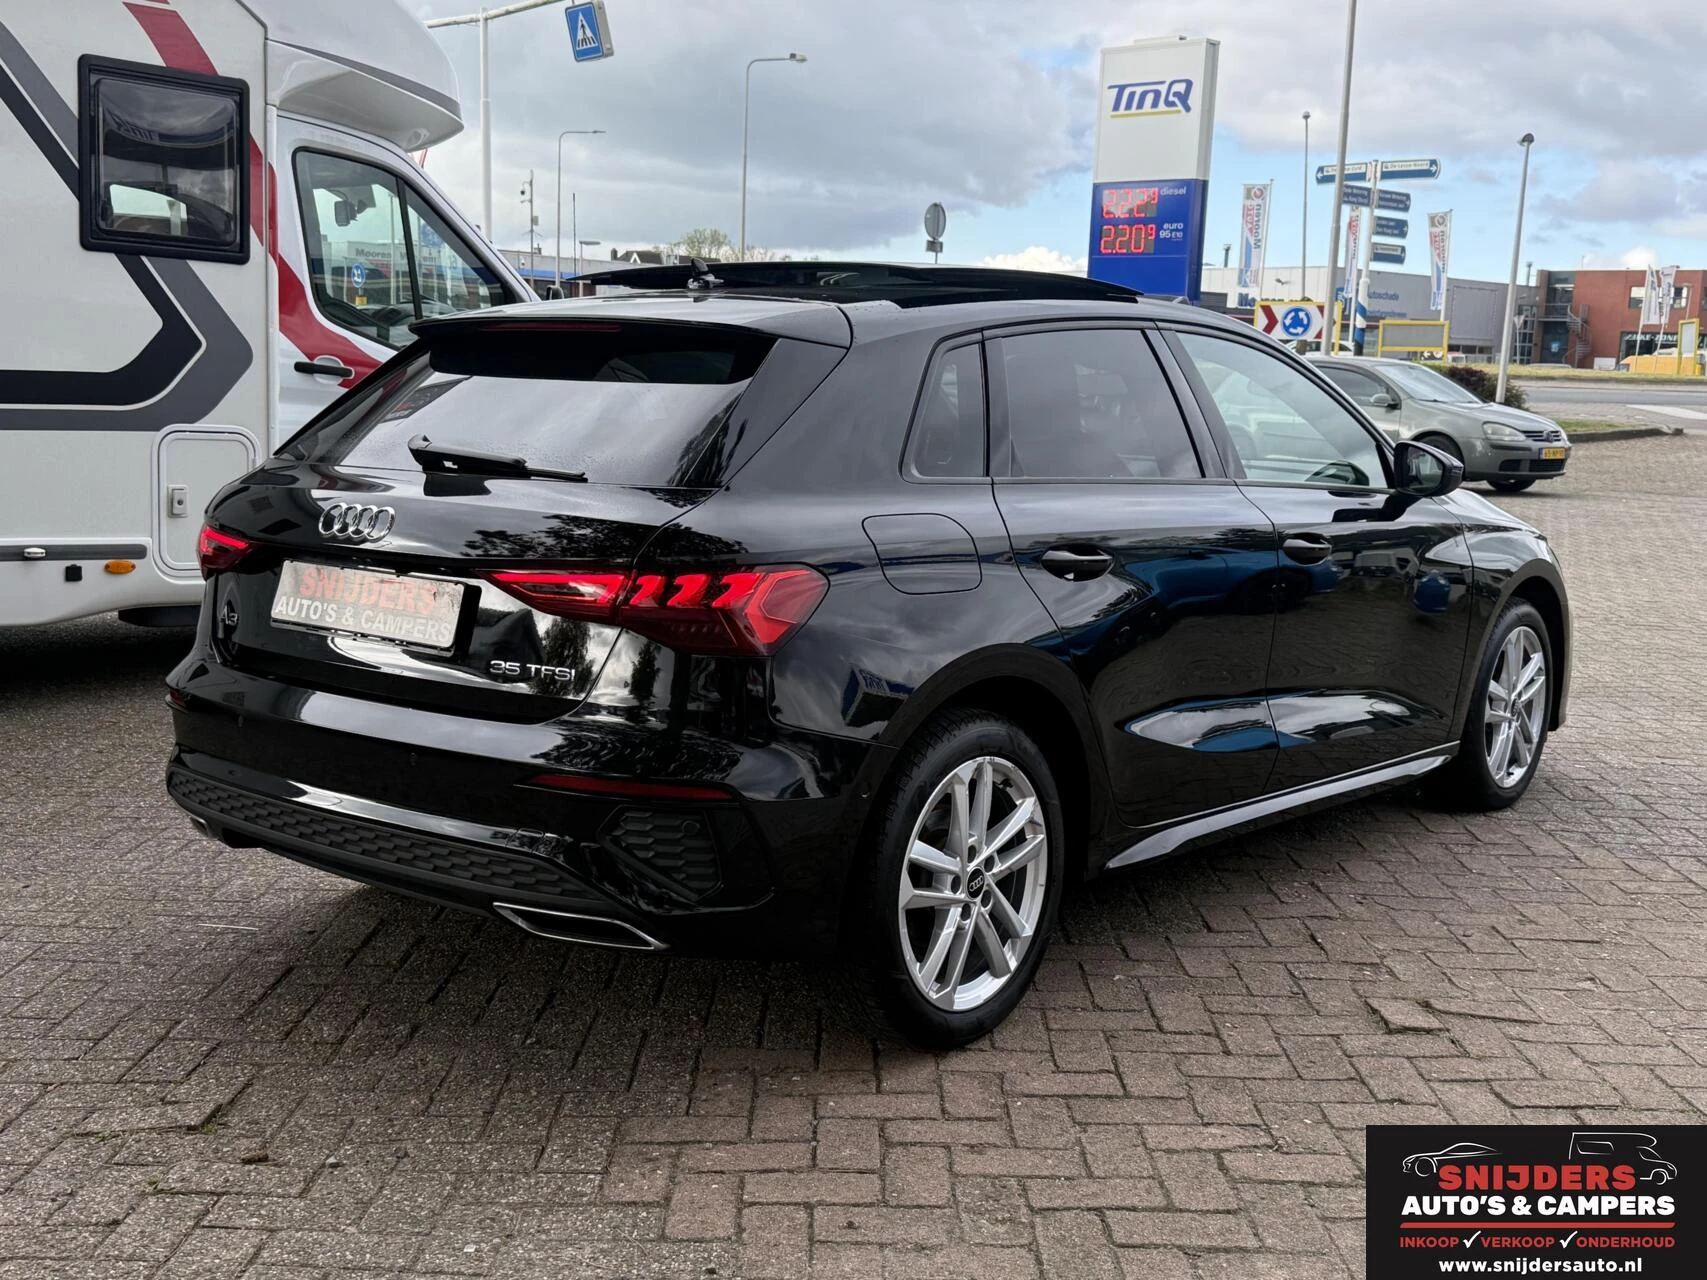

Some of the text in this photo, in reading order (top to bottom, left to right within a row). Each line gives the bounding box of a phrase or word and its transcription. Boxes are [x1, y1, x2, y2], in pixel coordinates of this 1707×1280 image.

[1160, 186, 1187, 196] diesel
[1163, 222, 1184, 230] euro
[1159, 230, 1171, 239] 95
[1368, 290, 1400, 301] utoschade
[300, 567, 437, 615] SNIJDERS
[221, 605, 238, 625] A3
[275, 595, 451, 642] AUTO'S & CAMPERS
[490, 660, 576, 681] 35 TFSI
